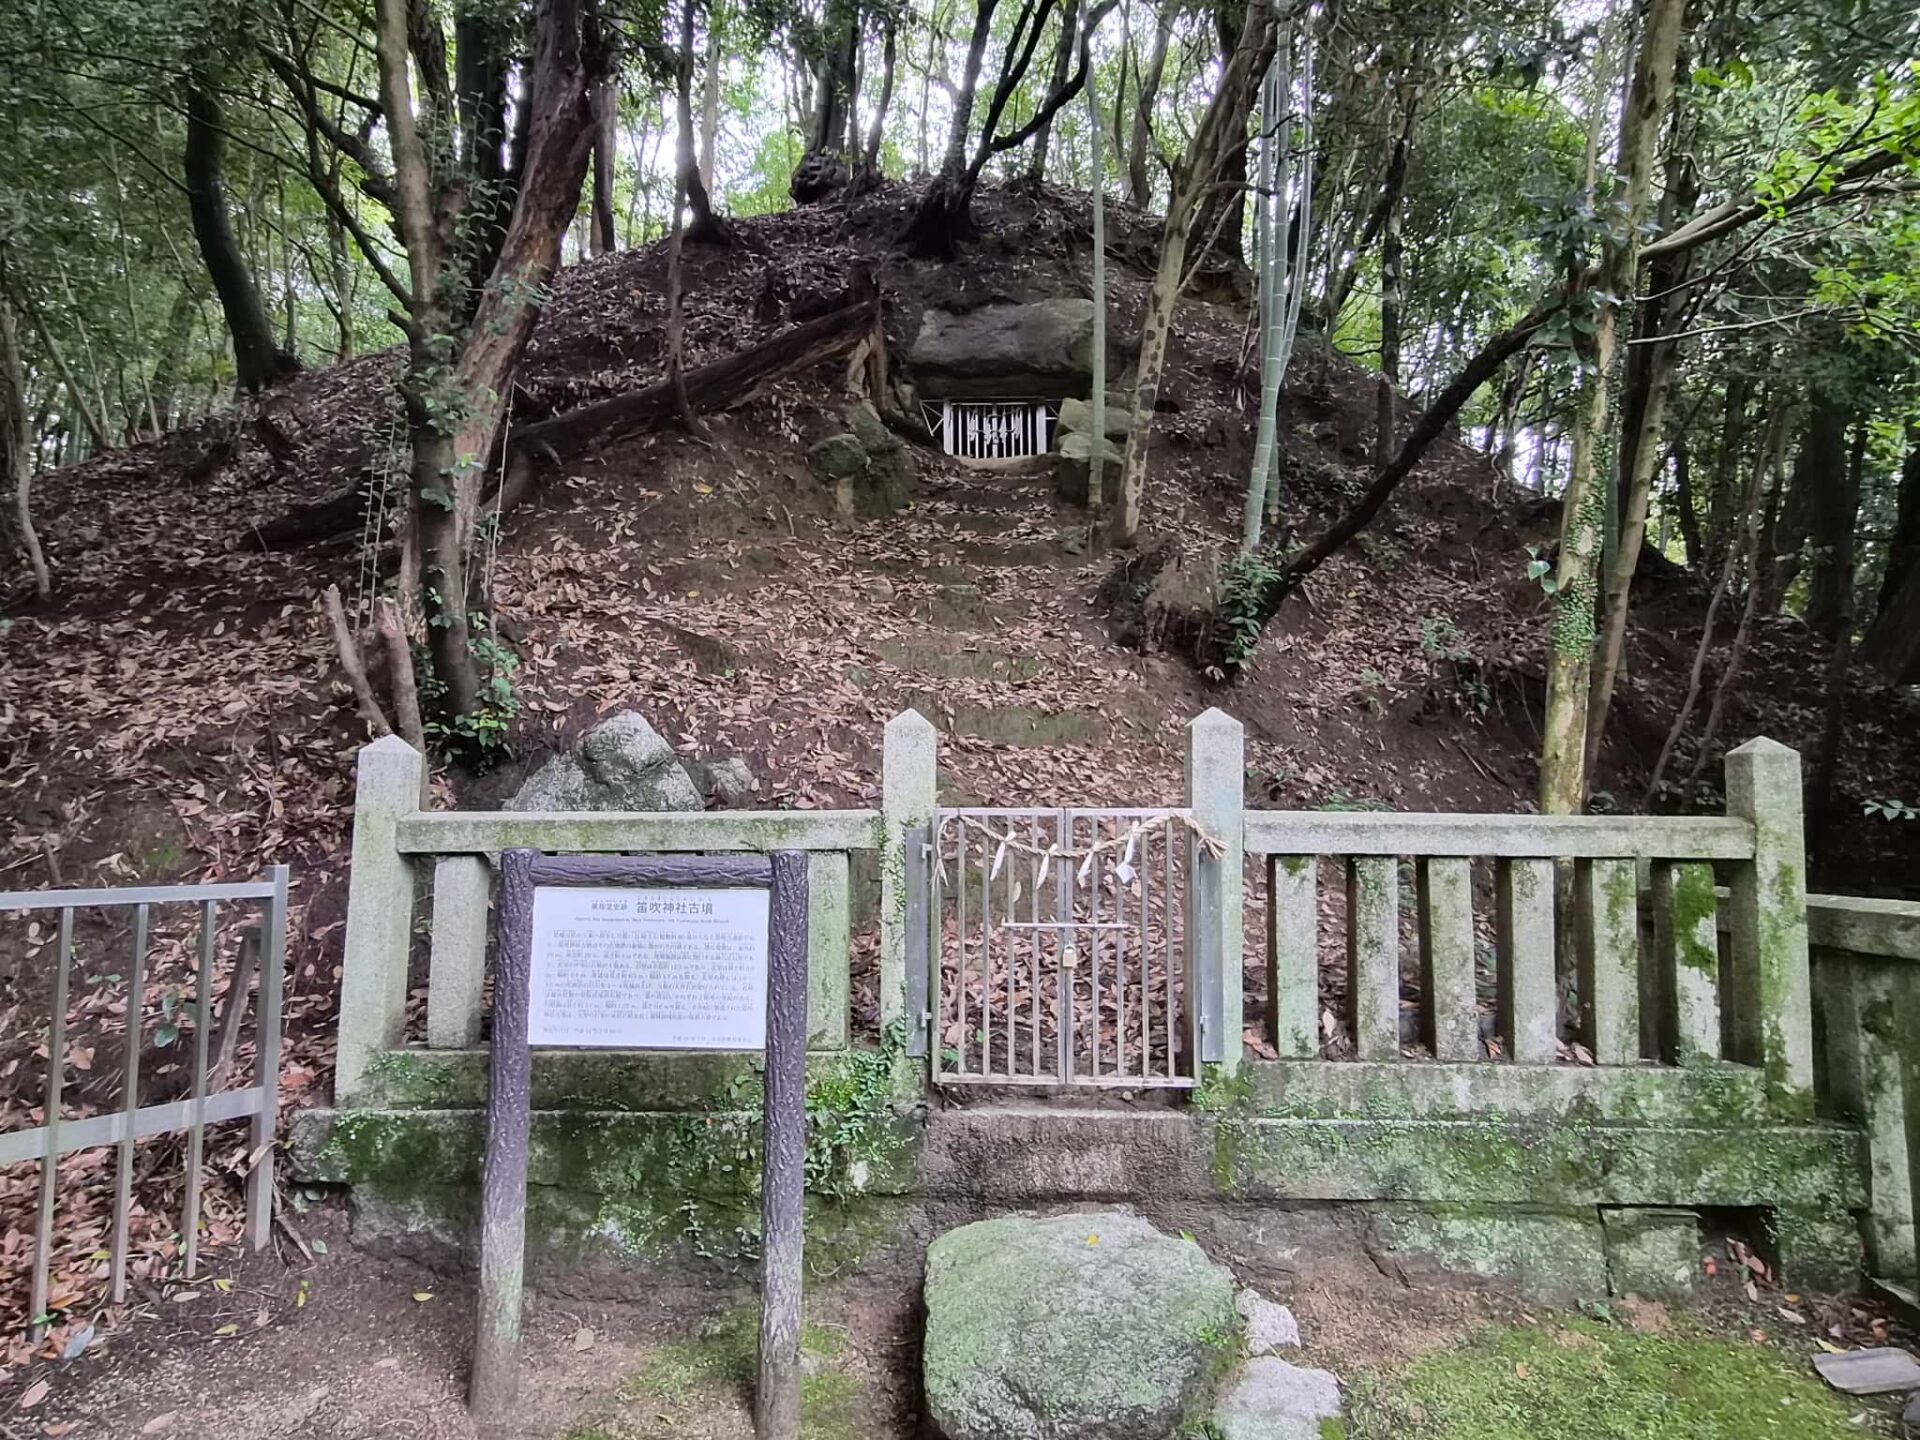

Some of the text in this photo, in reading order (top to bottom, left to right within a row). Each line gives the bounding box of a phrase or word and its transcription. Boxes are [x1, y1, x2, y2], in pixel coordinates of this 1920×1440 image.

[636, 902, 713, 915] 笛吹神社古墳
